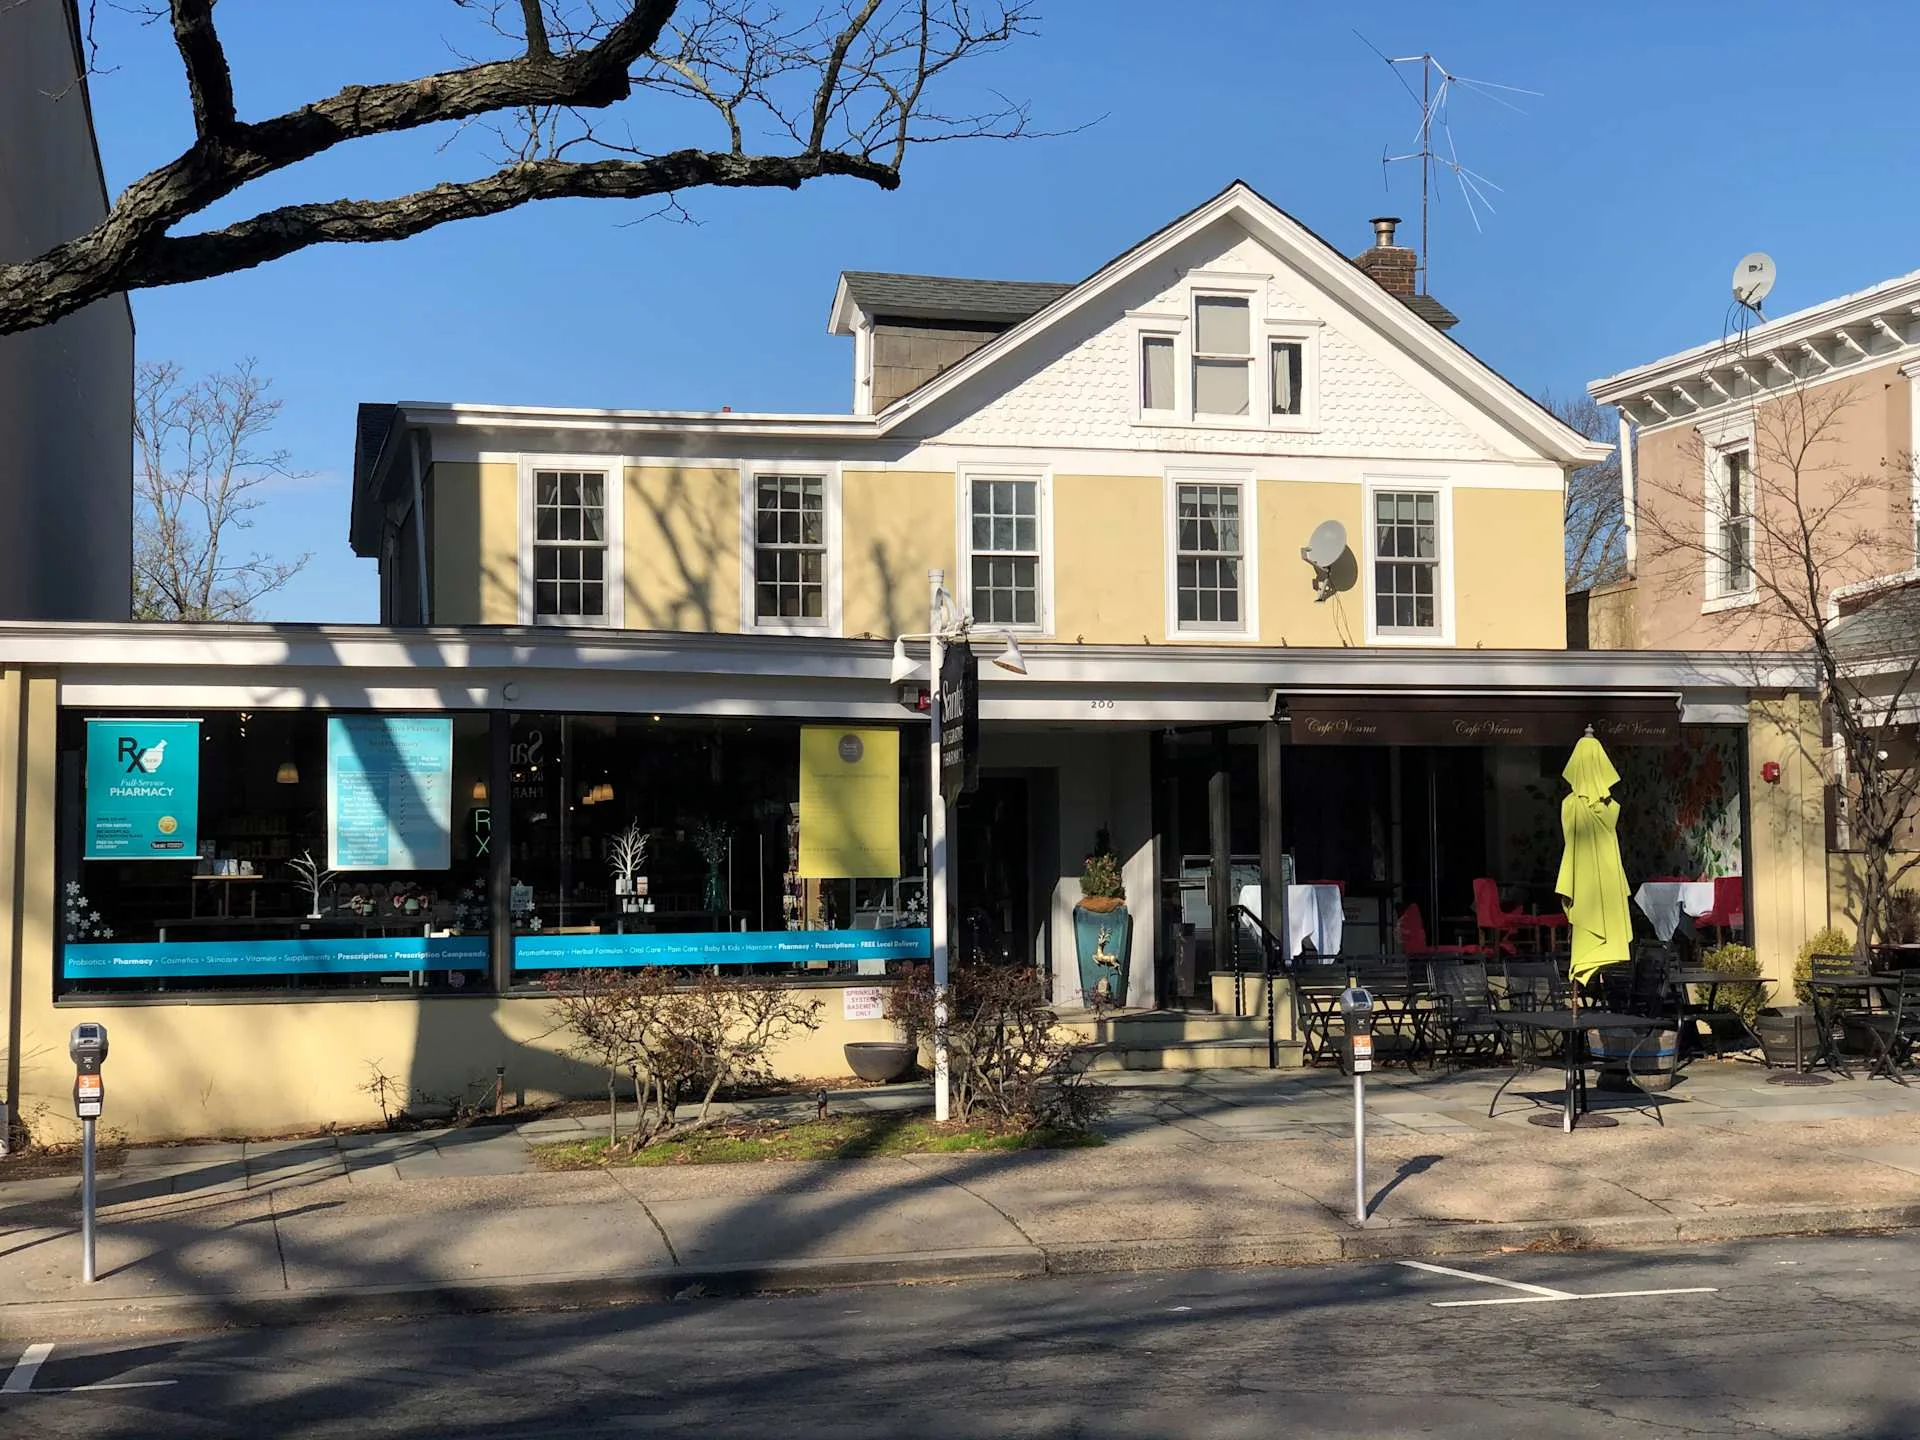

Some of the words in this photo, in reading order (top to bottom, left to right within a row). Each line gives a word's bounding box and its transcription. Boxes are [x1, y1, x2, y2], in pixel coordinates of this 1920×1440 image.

[942, 680, 964, 723] Santé
[1091, 701, 1114, 709] 200
[1335, 717, 1377, 734] Vienna
[1482, 718, 1523, 735] Vienna
[110, 787, 175, 797] PHARMACY
[518, 948, 565, 958] Aromatherapy
[571, 947, 594, 955] Herbal
[595, 947, 624, 955] Formulas
[629, 946, 645, 954] Oral
[704, 944, 721, 953] Baby
[745, 943, 773, 951] Haircare
[778, 943, 810, 952] Pharmacy
[815, 942, 856, 950] Prescriptions
[876, 940, 893, 948] Local
[894, 940, 920, 948] Delivery
[68, 958, 106, 967] Probiotics
[112, 957, 154, 967] Pharmacy
[160, 956, 200, 964] Cosmetics
[206, 955, 239, 964] Skincare
[246, 954, 277, 963] Vitamins
[283, 953, 331, 963] Supplements
[337, 952, 389, 961] Prescriptions
[394, 951, 441, 960] Prescription
